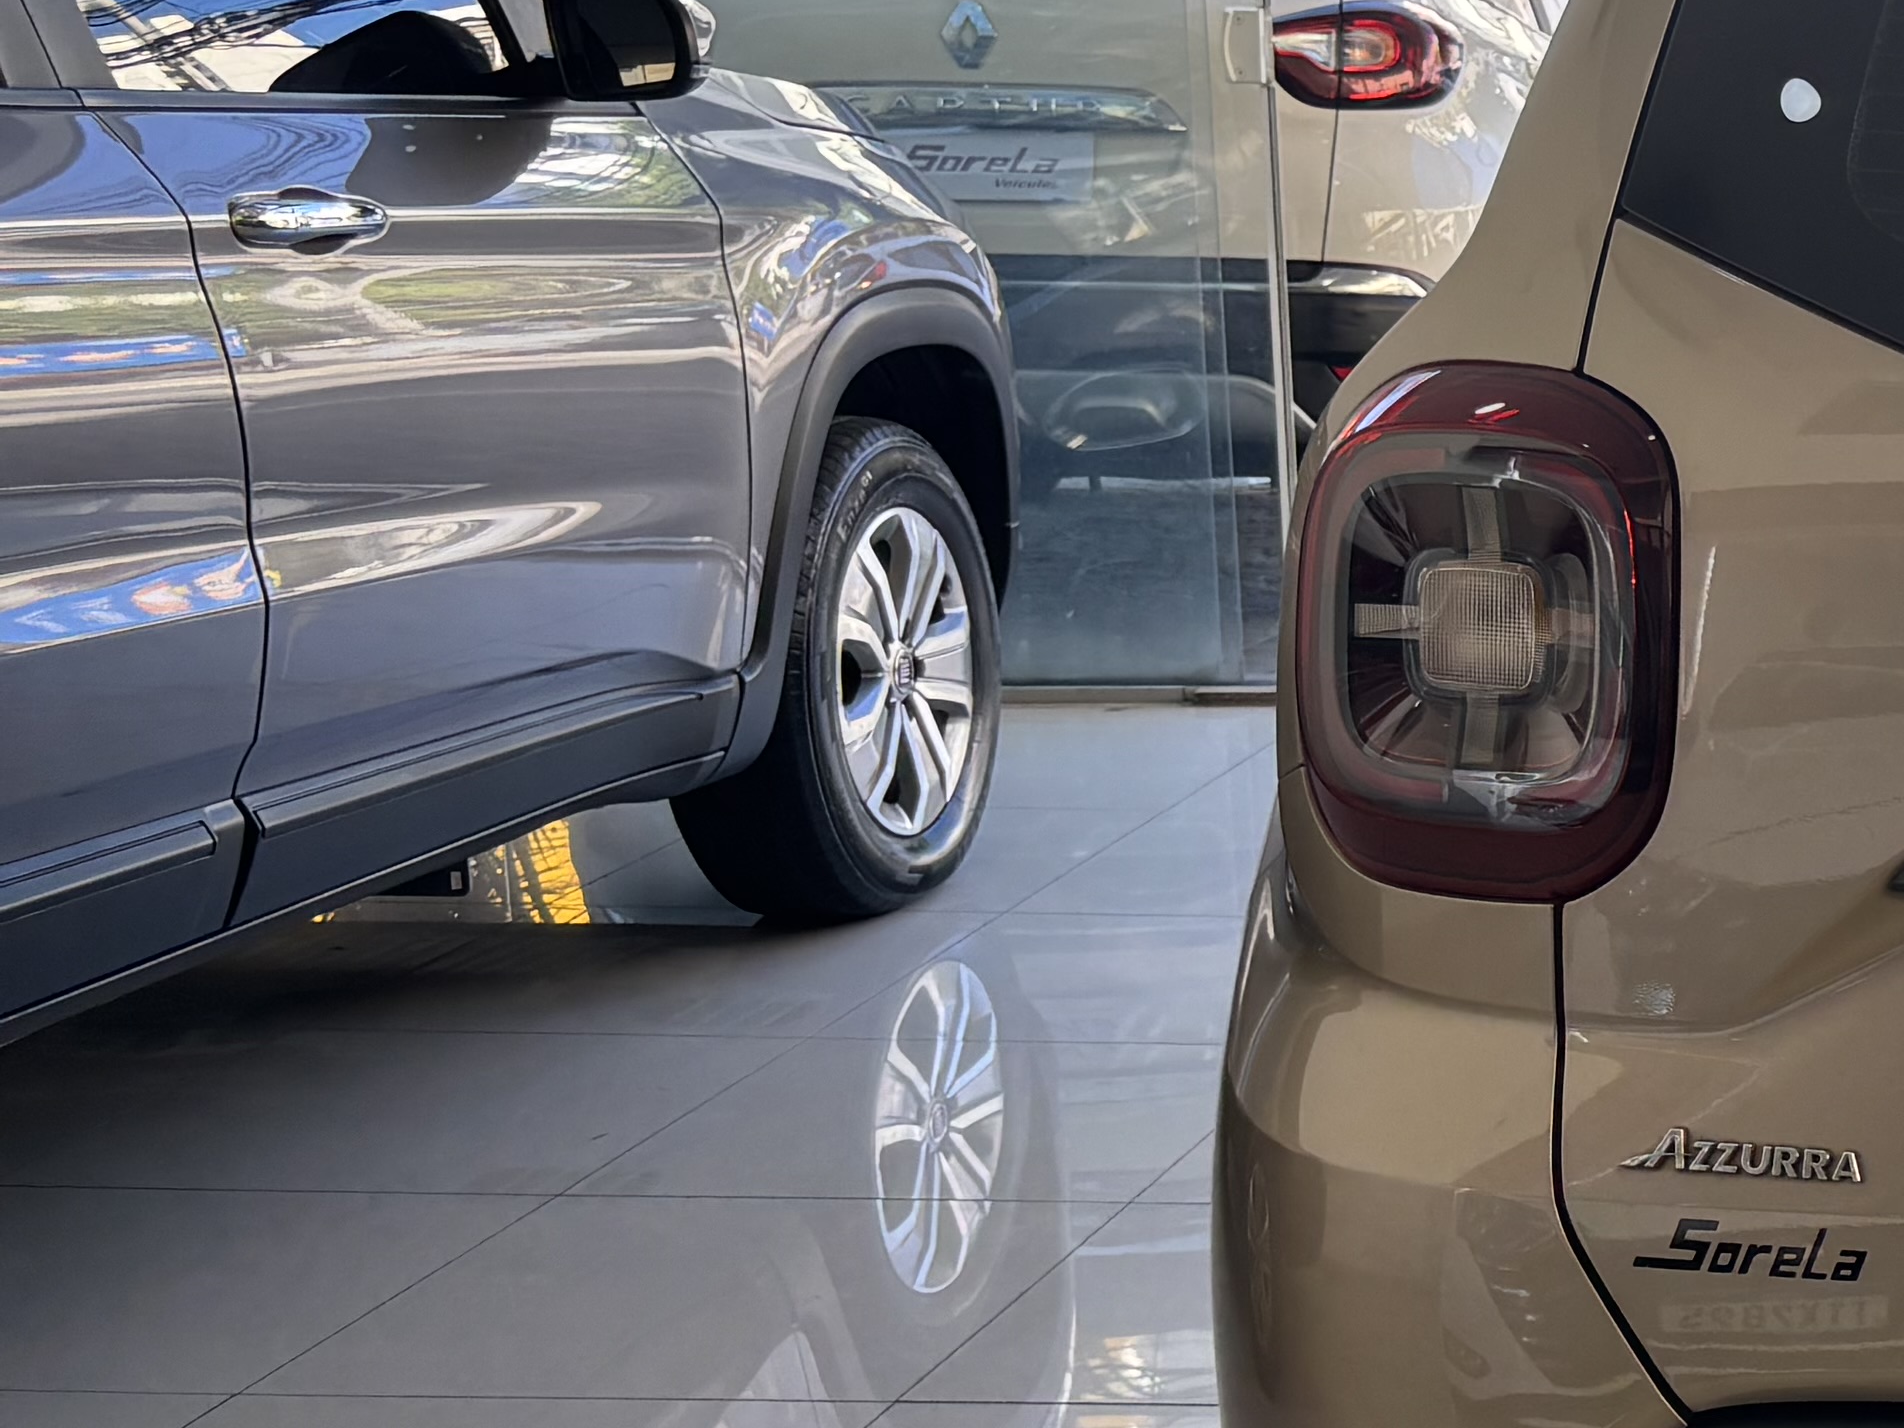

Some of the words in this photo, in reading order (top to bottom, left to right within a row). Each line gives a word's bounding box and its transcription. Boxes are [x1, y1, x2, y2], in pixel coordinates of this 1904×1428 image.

[906, 143, 1060, 175] SoreLa
[1619, 1127, 1863, 1183] AZZURRA
[1632, 1217, 1869, 1282] SoreLa
